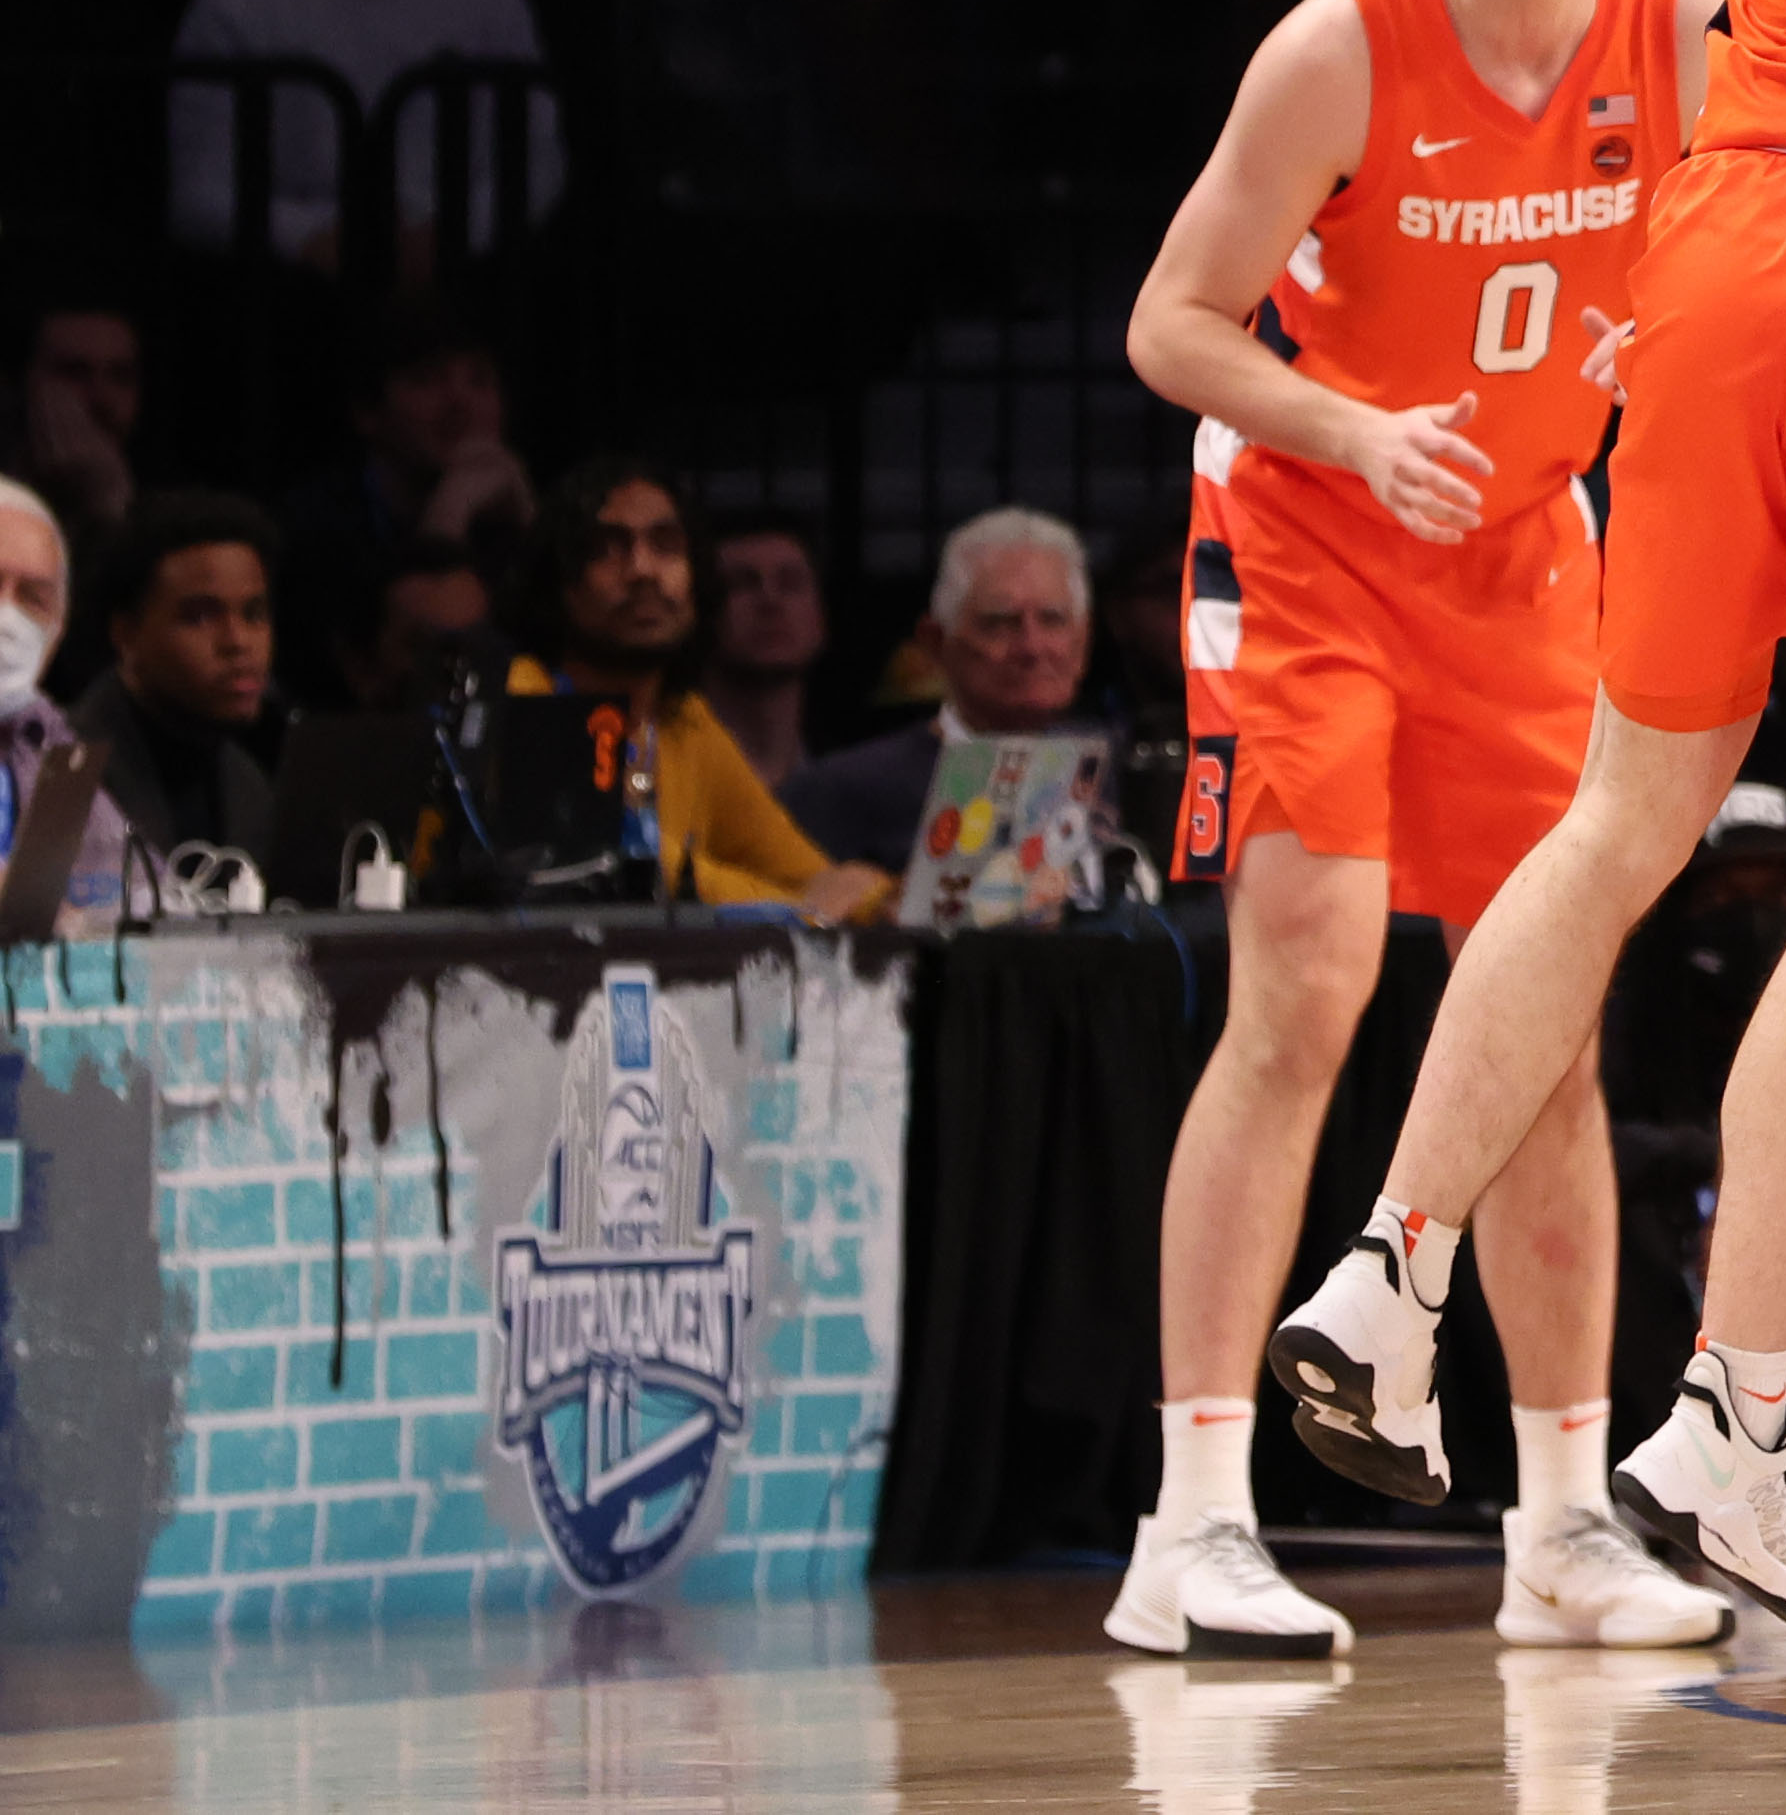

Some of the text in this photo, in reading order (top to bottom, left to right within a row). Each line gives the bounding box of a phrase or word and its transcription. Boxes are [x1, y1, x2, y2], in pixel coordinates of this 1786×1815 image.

[1397, 178, 1642, 246] SYRACUSE
[1472, 259, 1561, 375] 0
[1189, 751, 1231, 858] S
